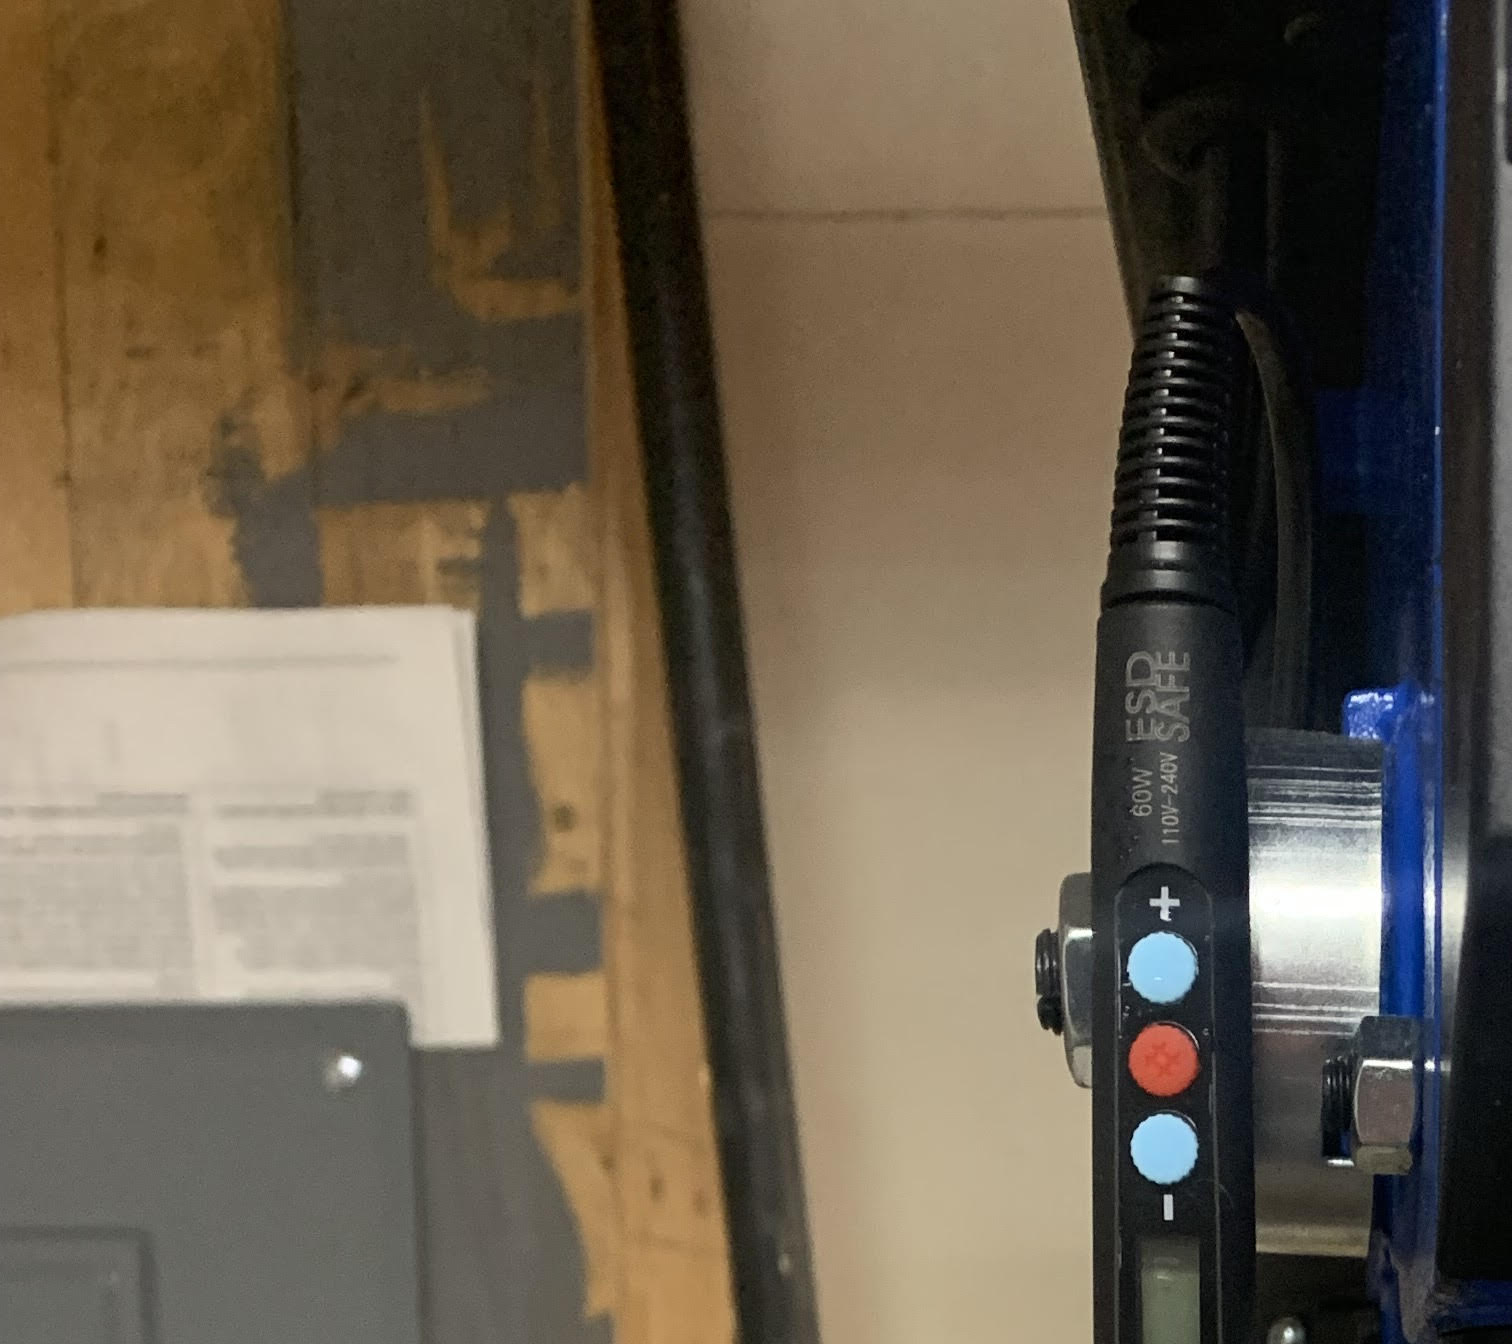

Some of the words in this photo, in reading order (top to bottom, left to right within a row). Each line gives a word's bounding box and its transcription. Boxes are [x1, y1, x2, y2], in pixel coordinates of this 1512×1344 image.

[1125, 650, 1157, 742] ESD
[1154, 650, 1191, 743] SAFE
[1129, 766, 1153, 818] 60W
[1159, 751, 1180, 845] 110V-240V
